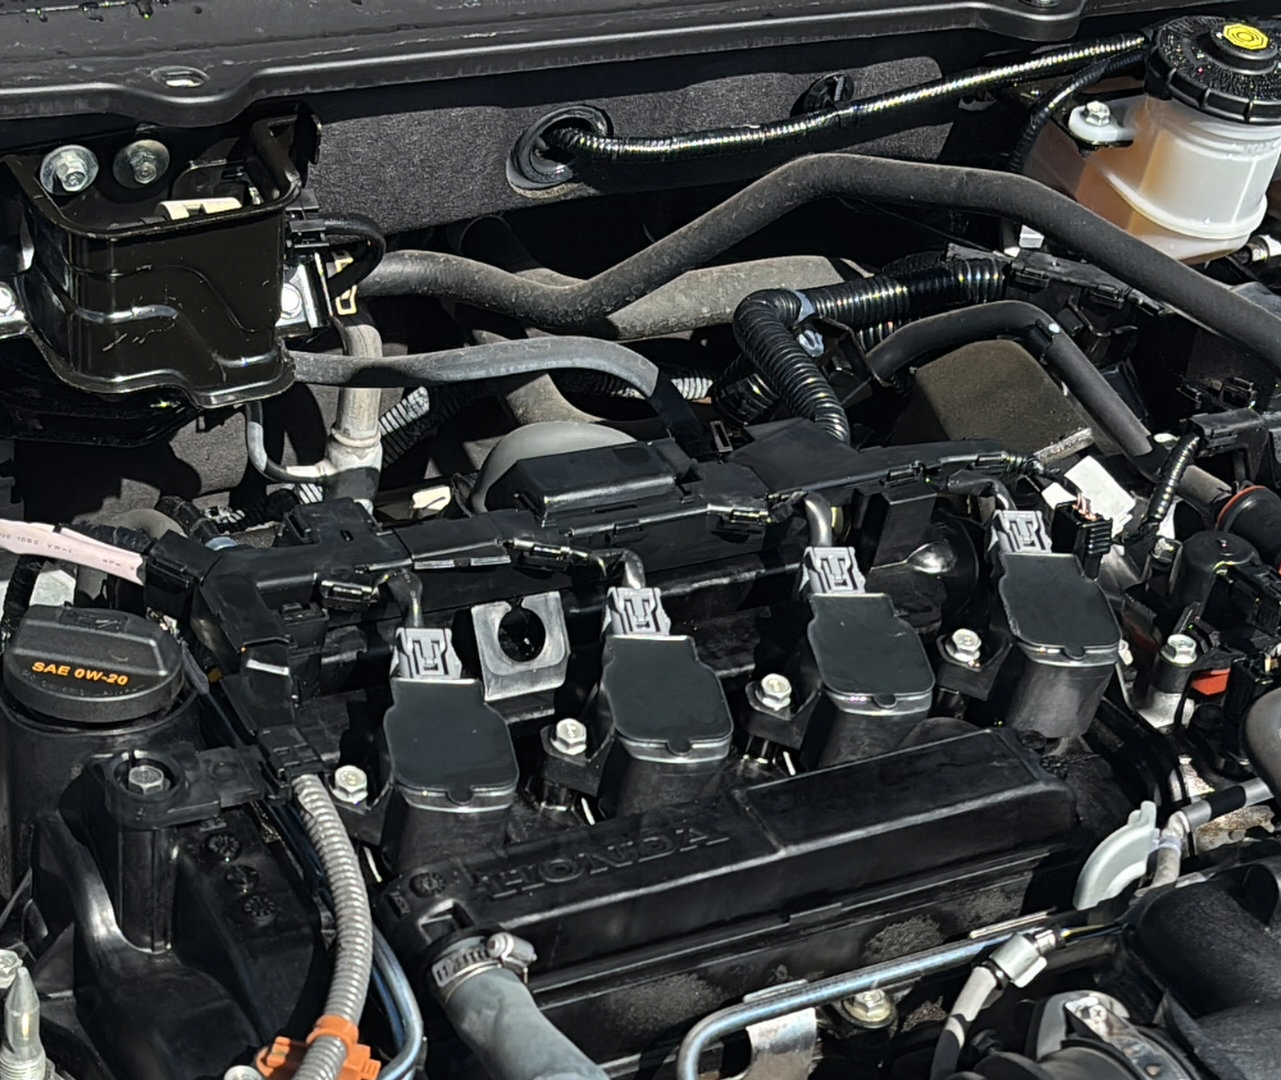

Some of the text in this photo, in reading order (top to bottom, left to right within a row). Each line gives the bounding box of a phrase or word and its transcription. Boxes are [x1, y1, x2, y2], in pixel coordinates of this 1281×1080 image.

[32, 661, 71, 676] SAE
[74, 668, 128, 686] 0W-20
[481, 828, 730, 898] HONDA
